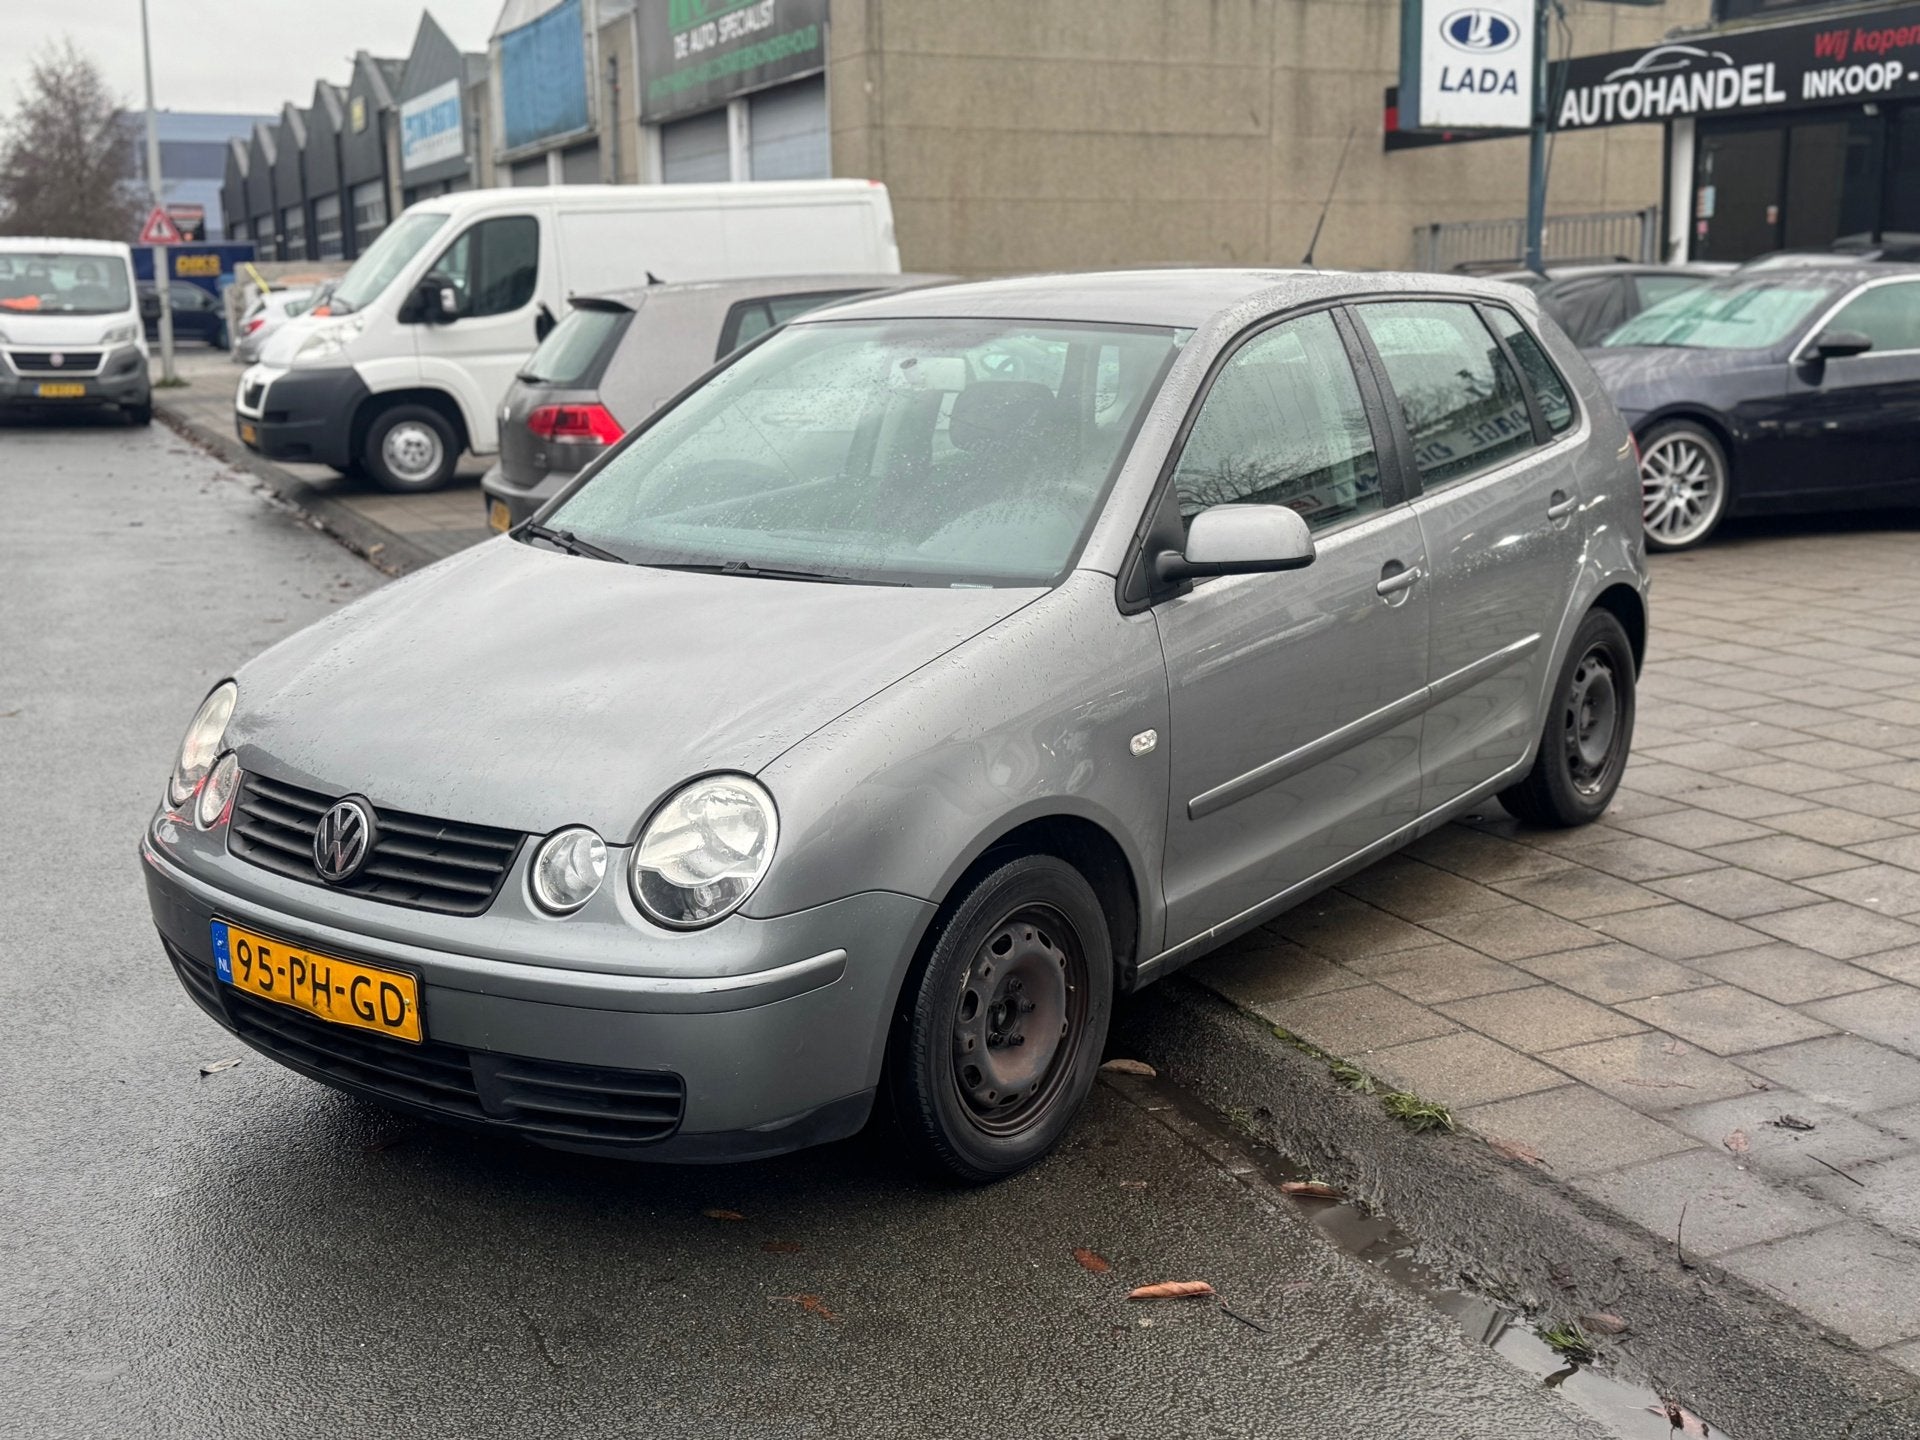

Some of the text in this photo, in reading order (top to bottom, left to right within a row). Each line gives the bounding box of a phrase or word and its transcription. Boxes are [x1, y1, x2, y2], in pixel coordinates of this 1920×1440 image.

[690, 22, 717, 51] AUTO
[1815, 29, 1850, 62] Wij
[1439, 66, 1518, 95] LADA
[1558, 63, 1787, 127] AUTOHANDEL
[1803, 60, 1903, 99] INKOOP
[218, 957, 230, 973] NL
[236, 939, 406, 1027] 95-PH-GD
